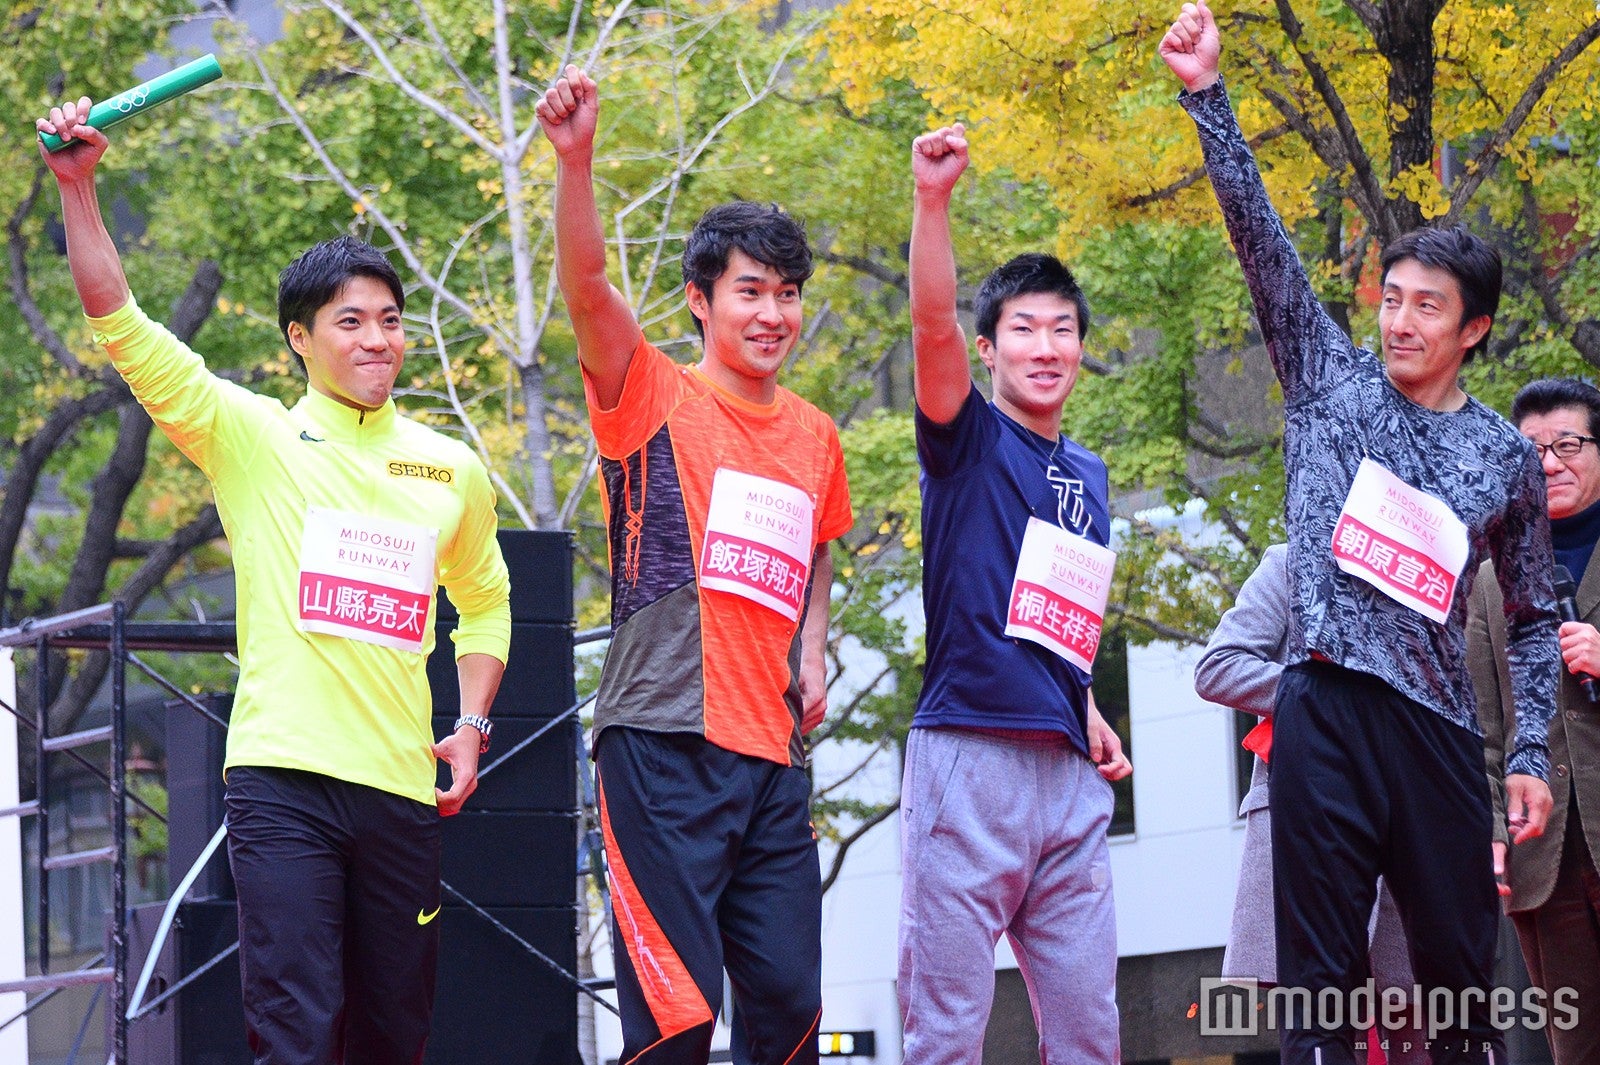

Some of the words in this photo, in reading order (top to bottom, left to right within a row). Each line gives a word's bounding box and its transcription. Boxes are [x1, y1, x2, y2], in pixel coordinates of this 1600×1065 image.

[389, 462, 452, 483] SEIKO
[746, 491, 805, 521] MIDOSUJI
[1386, 487, 1443, 527] MIDOSUJI
[340, 528, 415, 551] MIDOSUJI
[744, 510, 800, 541] RUNWAY
[1378, 505, 1436, 544] RUNWAY
[338, 548, 410, 572] RUNWAY
[706, 539, 803, 603] 飯塚翔太
[1054, 543, 1107, 576] MIDOSUJI
[1336, 522, 1449, 605] 朝原宣治
[1051, 562, 1101, 594] RUNWAY
[303, 581, 424, 635] 山縣亮太
[1015, 587, 1099, 655] 桐生祥秀
